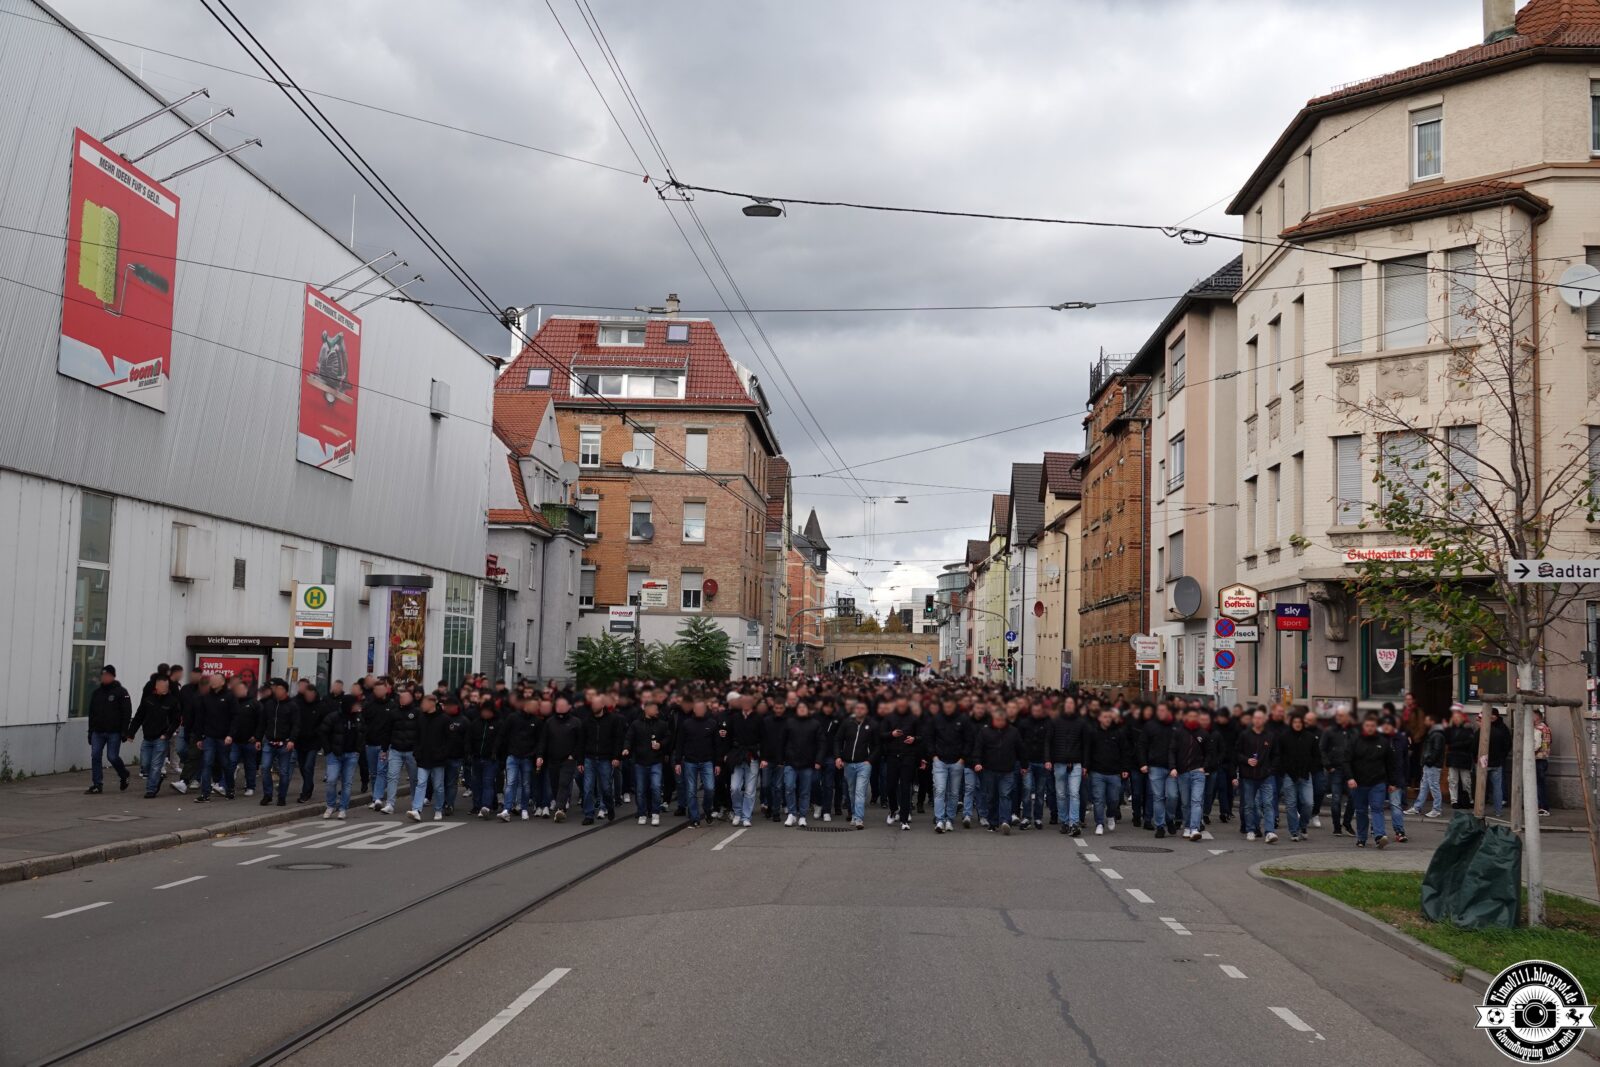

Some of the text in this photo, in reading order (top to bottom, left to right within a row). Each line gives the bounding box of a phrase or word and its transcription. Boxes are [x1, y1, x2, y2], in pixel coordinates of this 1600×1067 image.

[99, 157, 115, 175] MEHR
[116, 167, 131, 185] IDEEN
[129, 365, 155, 382] toom
[1347, 548, 1407, 561] Stuttgarter
[1538, 563, 1600, 578] adtar
[1224, 600, 1255, 608] Hofbräu
[1284, 605, 1301, 616] sky
[1231, 629, 1256, 638] rlseck
